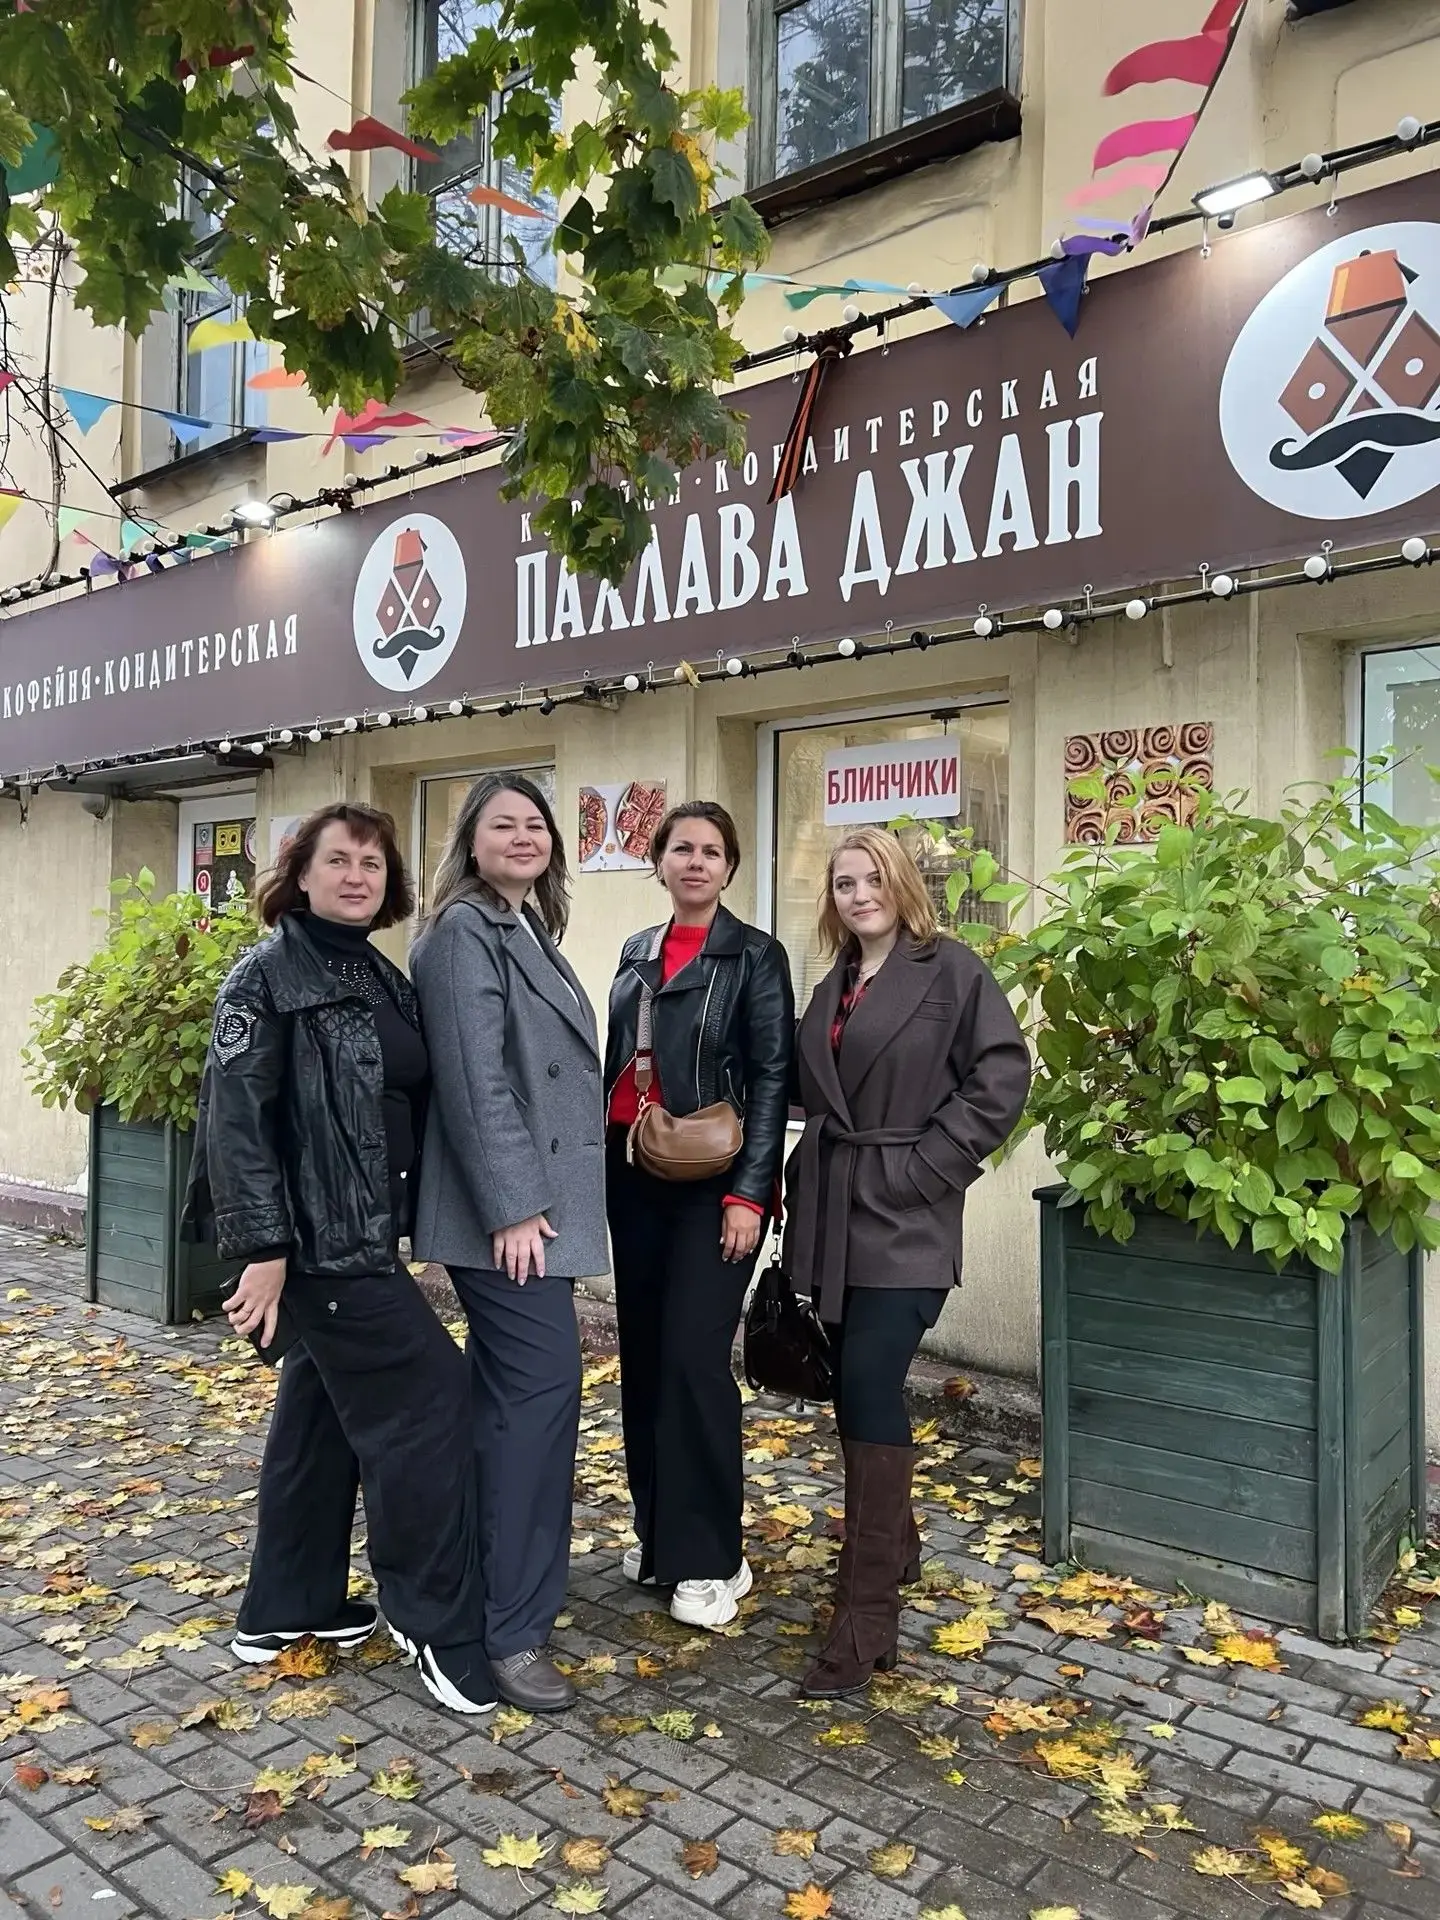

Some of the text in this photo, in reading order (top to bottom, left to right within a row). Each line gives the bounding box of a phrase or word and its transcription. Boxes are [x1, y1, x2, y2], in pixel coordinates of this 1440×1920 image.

[838, 411, 1104, 602] ДЖАН
[3, 613, 298, 719] КОФЕЙНЯ КОНДИТЕРСКАЯ
[827, 756, 957, 805] БЛИНЧИКИ
